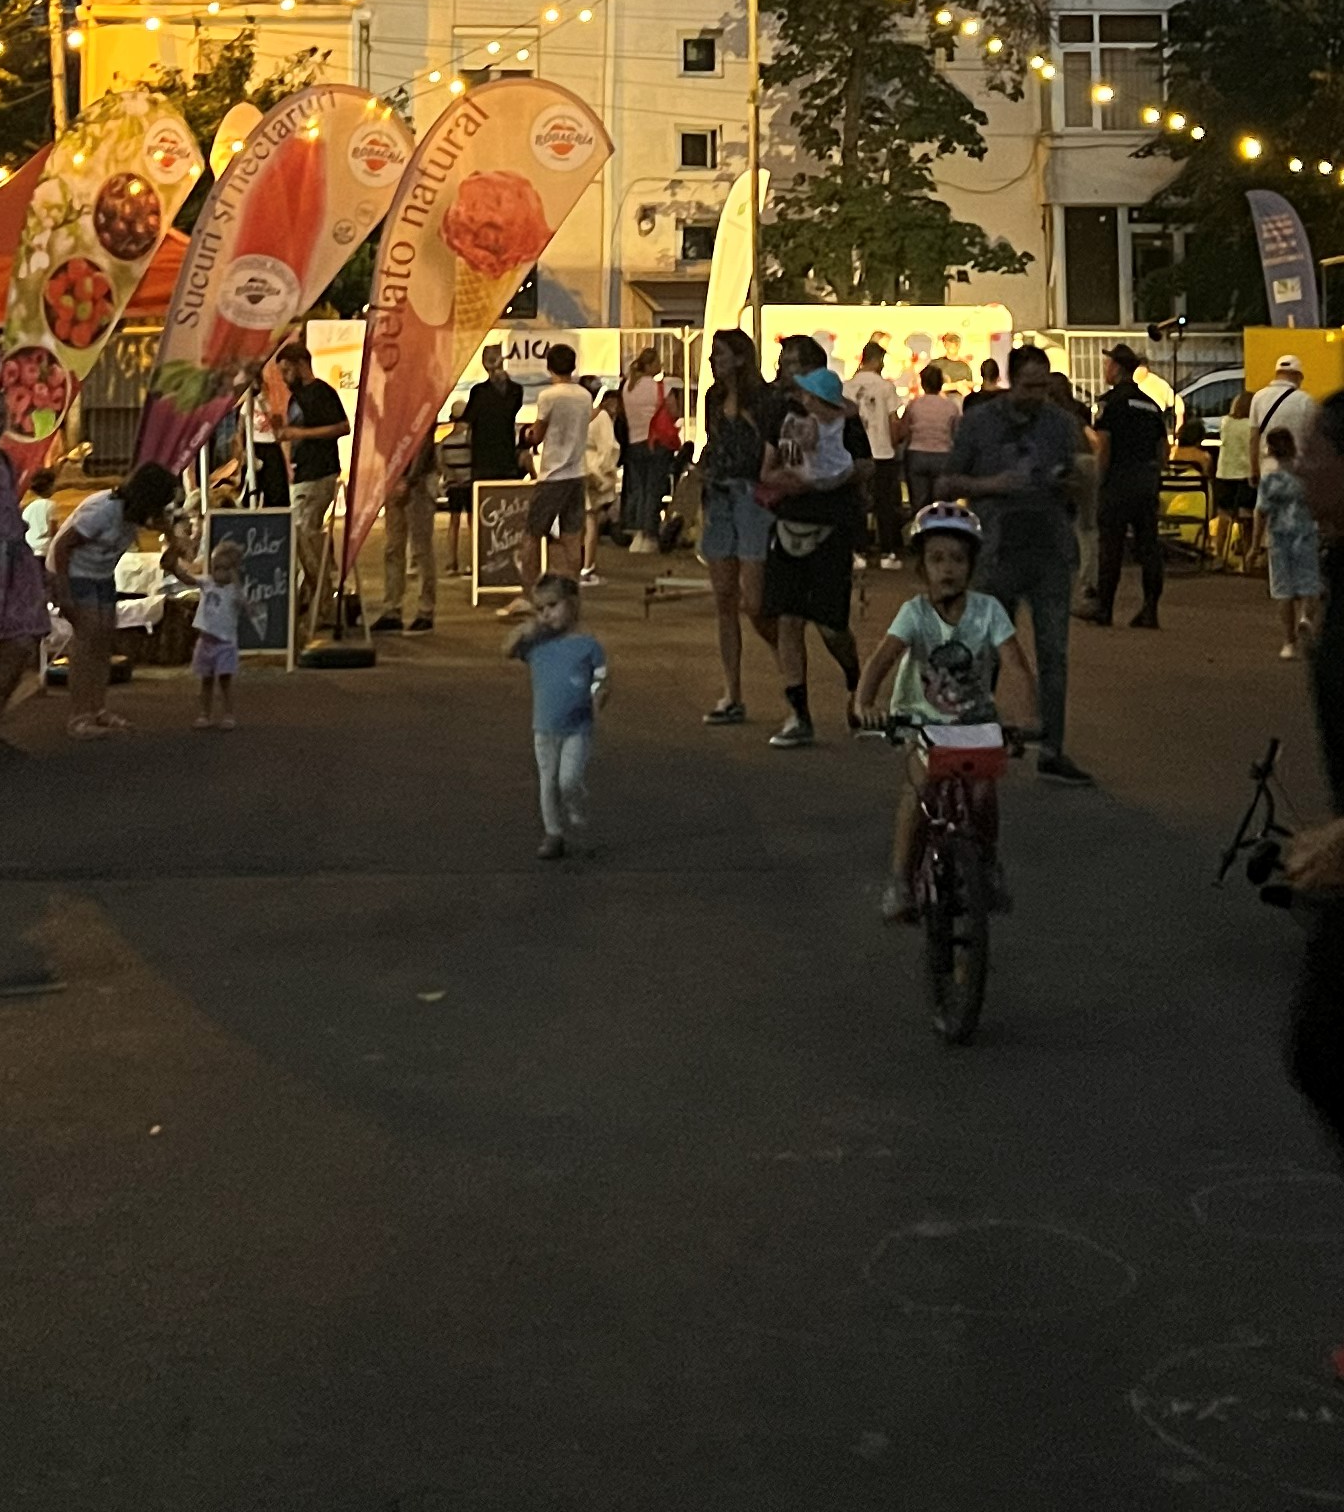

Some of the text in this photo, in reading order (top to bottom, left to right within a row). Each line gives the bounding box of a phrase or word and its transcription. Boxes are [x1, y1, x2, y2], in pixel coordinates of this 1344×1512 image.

[174, 229, 222, 329] Sucuri
[219, 90, 336, 208] nectaruri
[369, 94, 490, 371] Gelato natural
